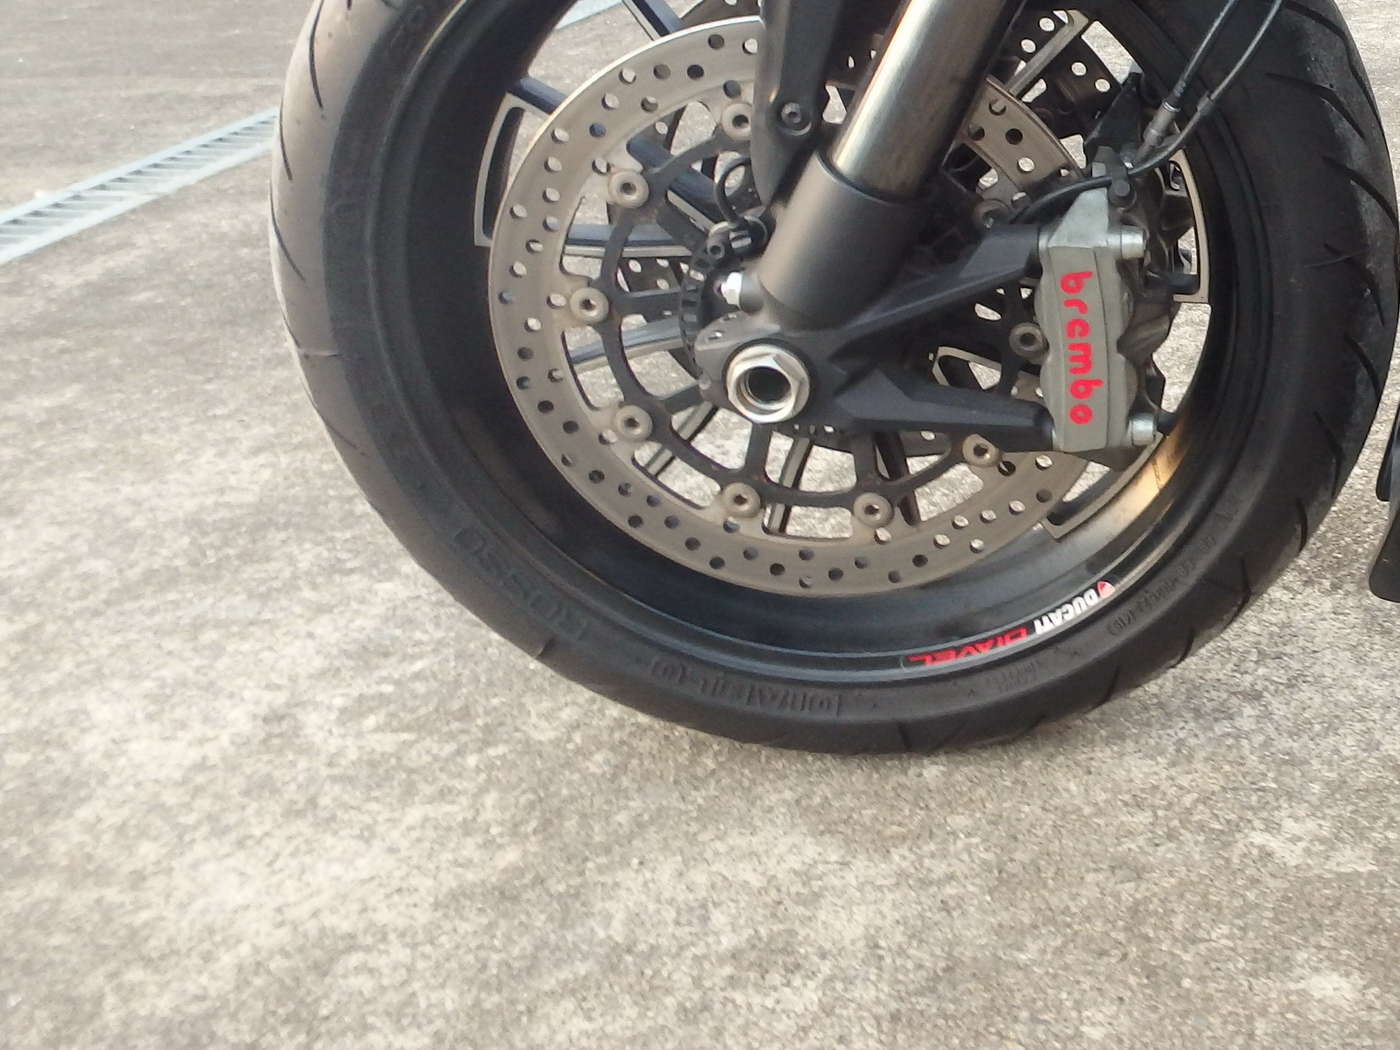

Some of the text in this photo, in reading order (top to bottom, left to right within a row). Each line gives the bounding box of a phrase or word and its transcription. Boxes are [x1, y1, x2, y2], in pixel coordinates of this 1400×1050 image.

[1060, 271, 1104, 425] brembo
[906, 587, 1099, 667] DUCATI DIAVEL
